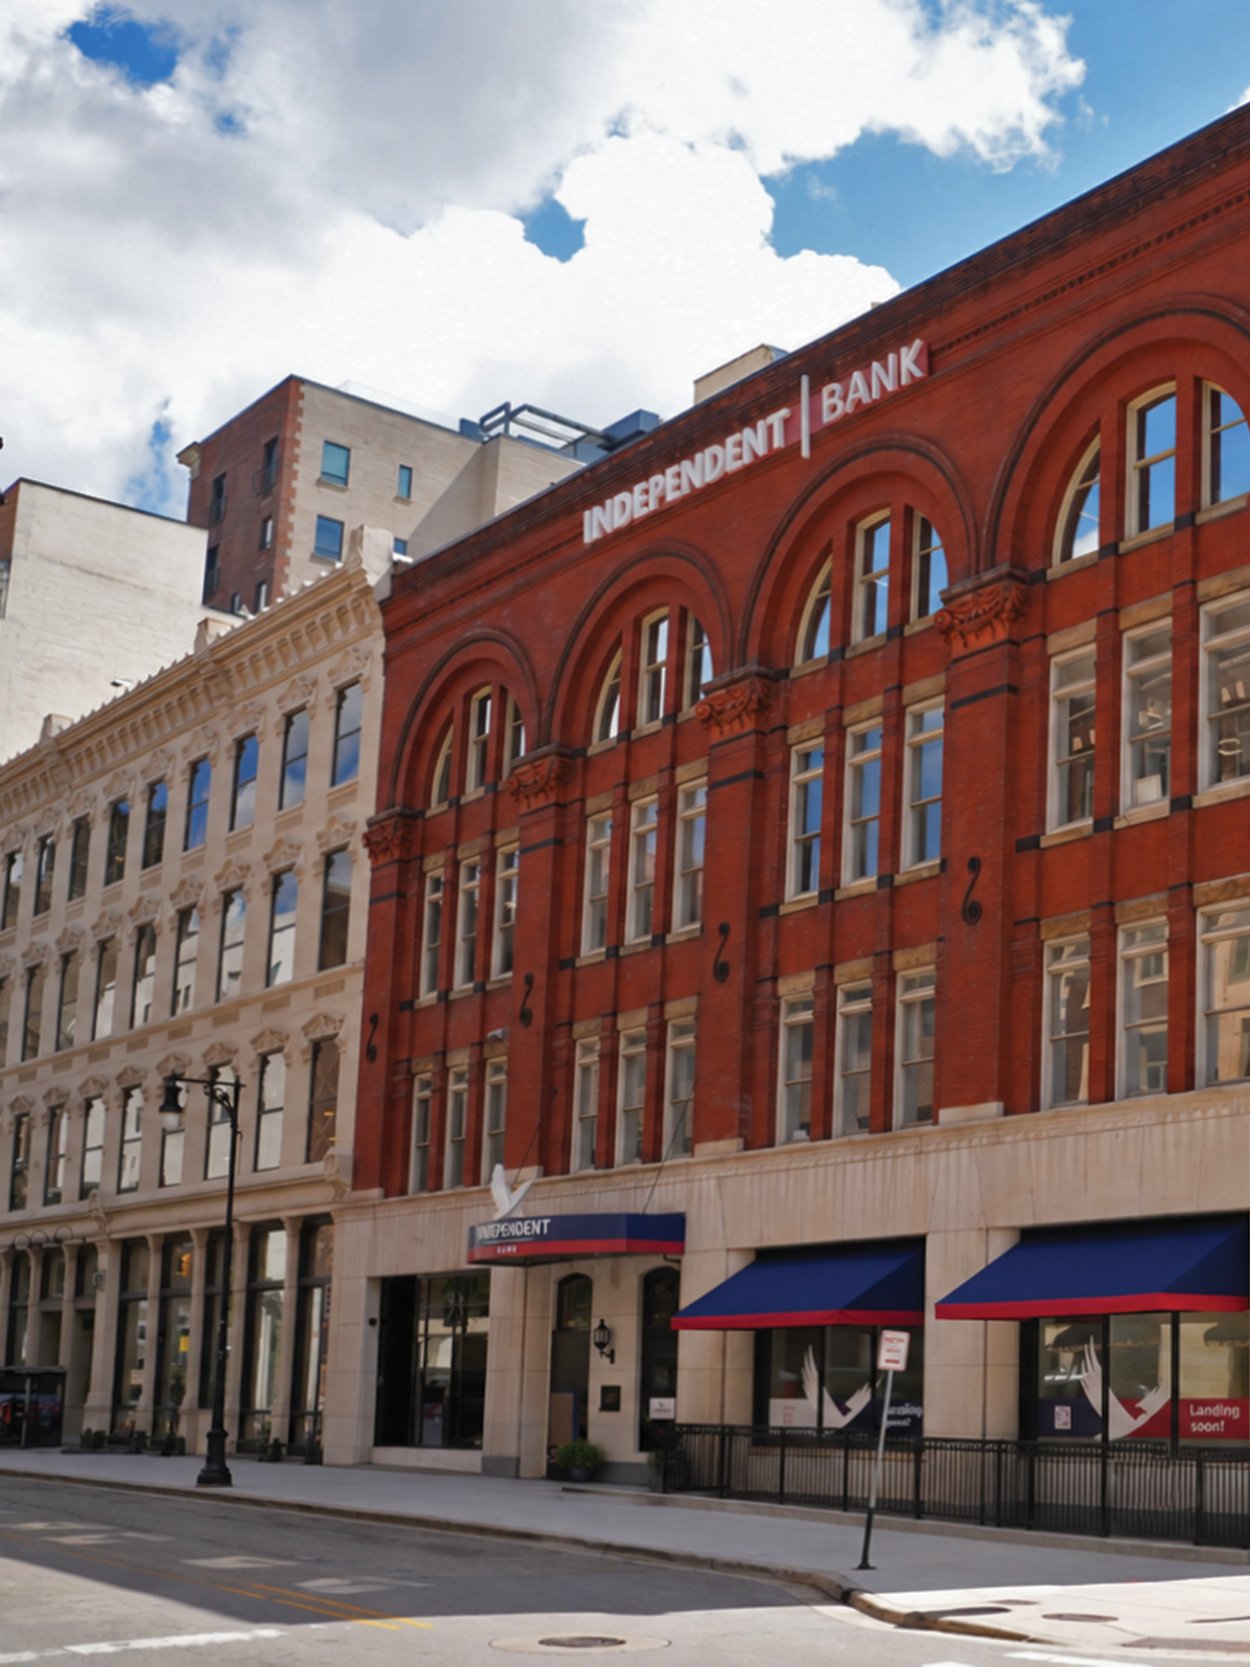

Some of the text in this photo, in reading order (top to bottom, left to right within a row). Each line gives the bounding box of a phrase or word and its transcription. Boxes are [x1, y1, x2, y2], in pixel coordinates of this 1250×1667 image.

[583, 338, 924, 543] INDEPENDENT BANK
[1190, 1404, 1240, 1419] Landing
[1191, 1420, 1225, 1432] soon!
